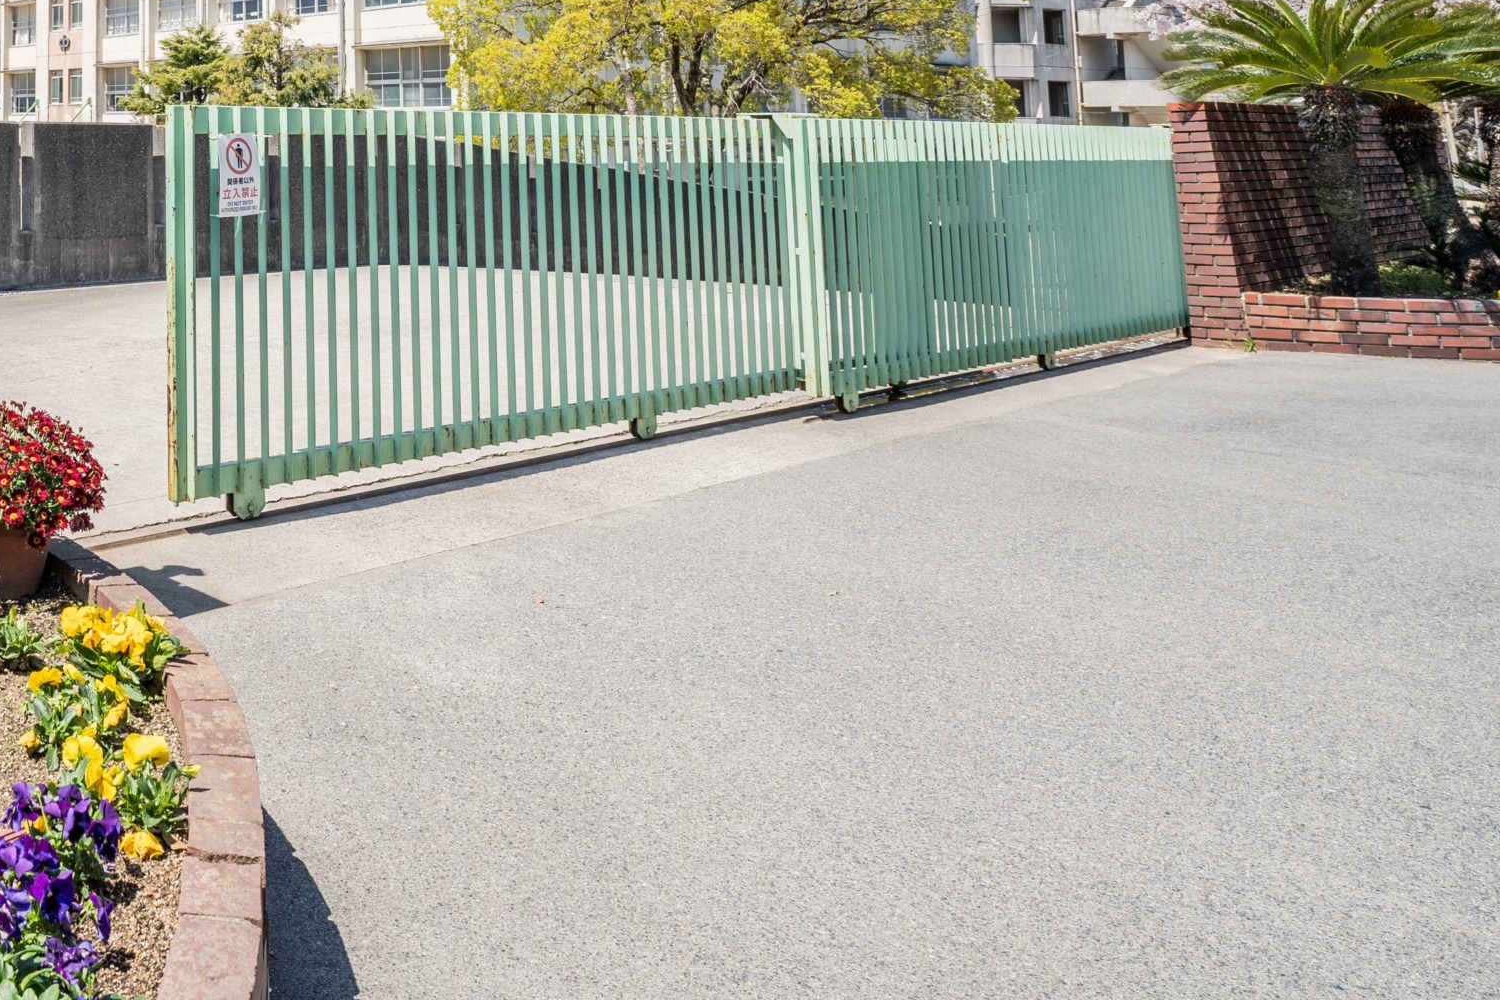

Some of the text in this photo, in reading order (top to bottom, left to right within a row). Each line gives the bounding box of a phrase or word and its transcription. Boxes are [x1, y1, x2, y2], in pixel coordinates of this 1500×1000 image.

[227, 176, 254, 185] 関係者以外
[222, 187, 258, 199] 立入禁止
